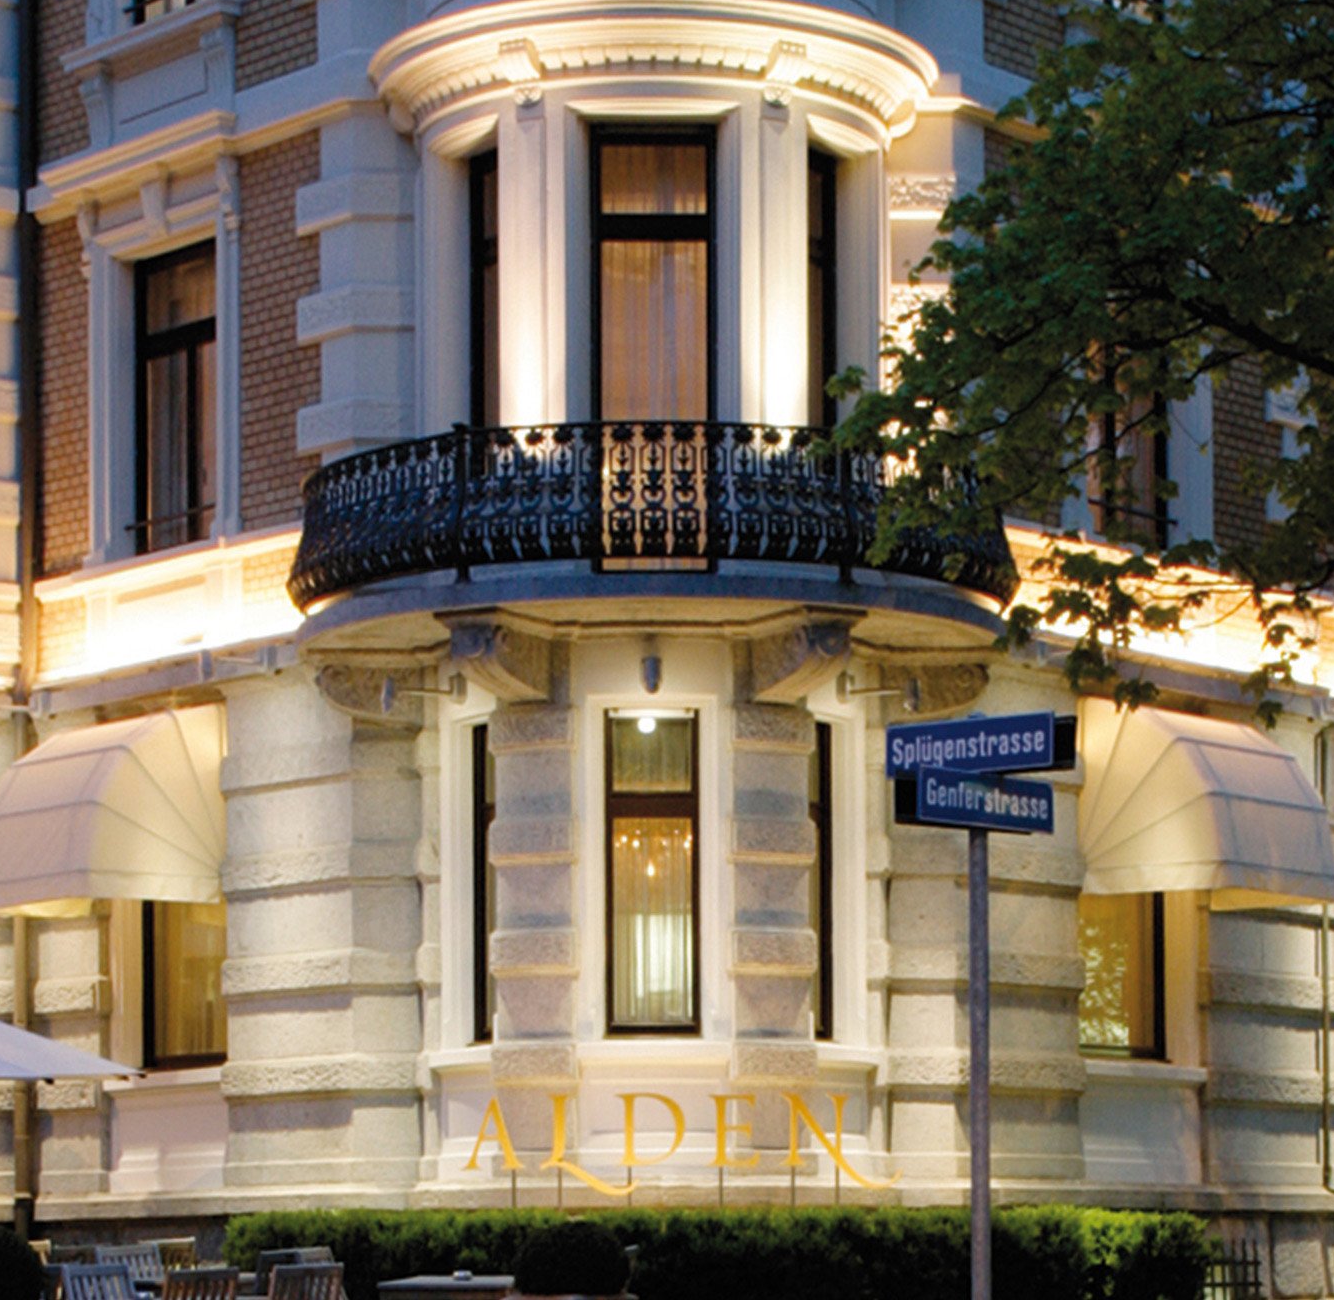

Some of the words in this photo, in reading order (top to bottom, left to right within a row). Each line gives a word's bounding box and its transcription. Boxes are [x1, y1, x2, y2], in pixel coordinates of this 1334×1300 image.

[891, 729, 1045, 770] Splügenstrasse
[926, 777, 1049, 820] Genferstrasse
[460, 1091, 903, 1196] ALDEN
